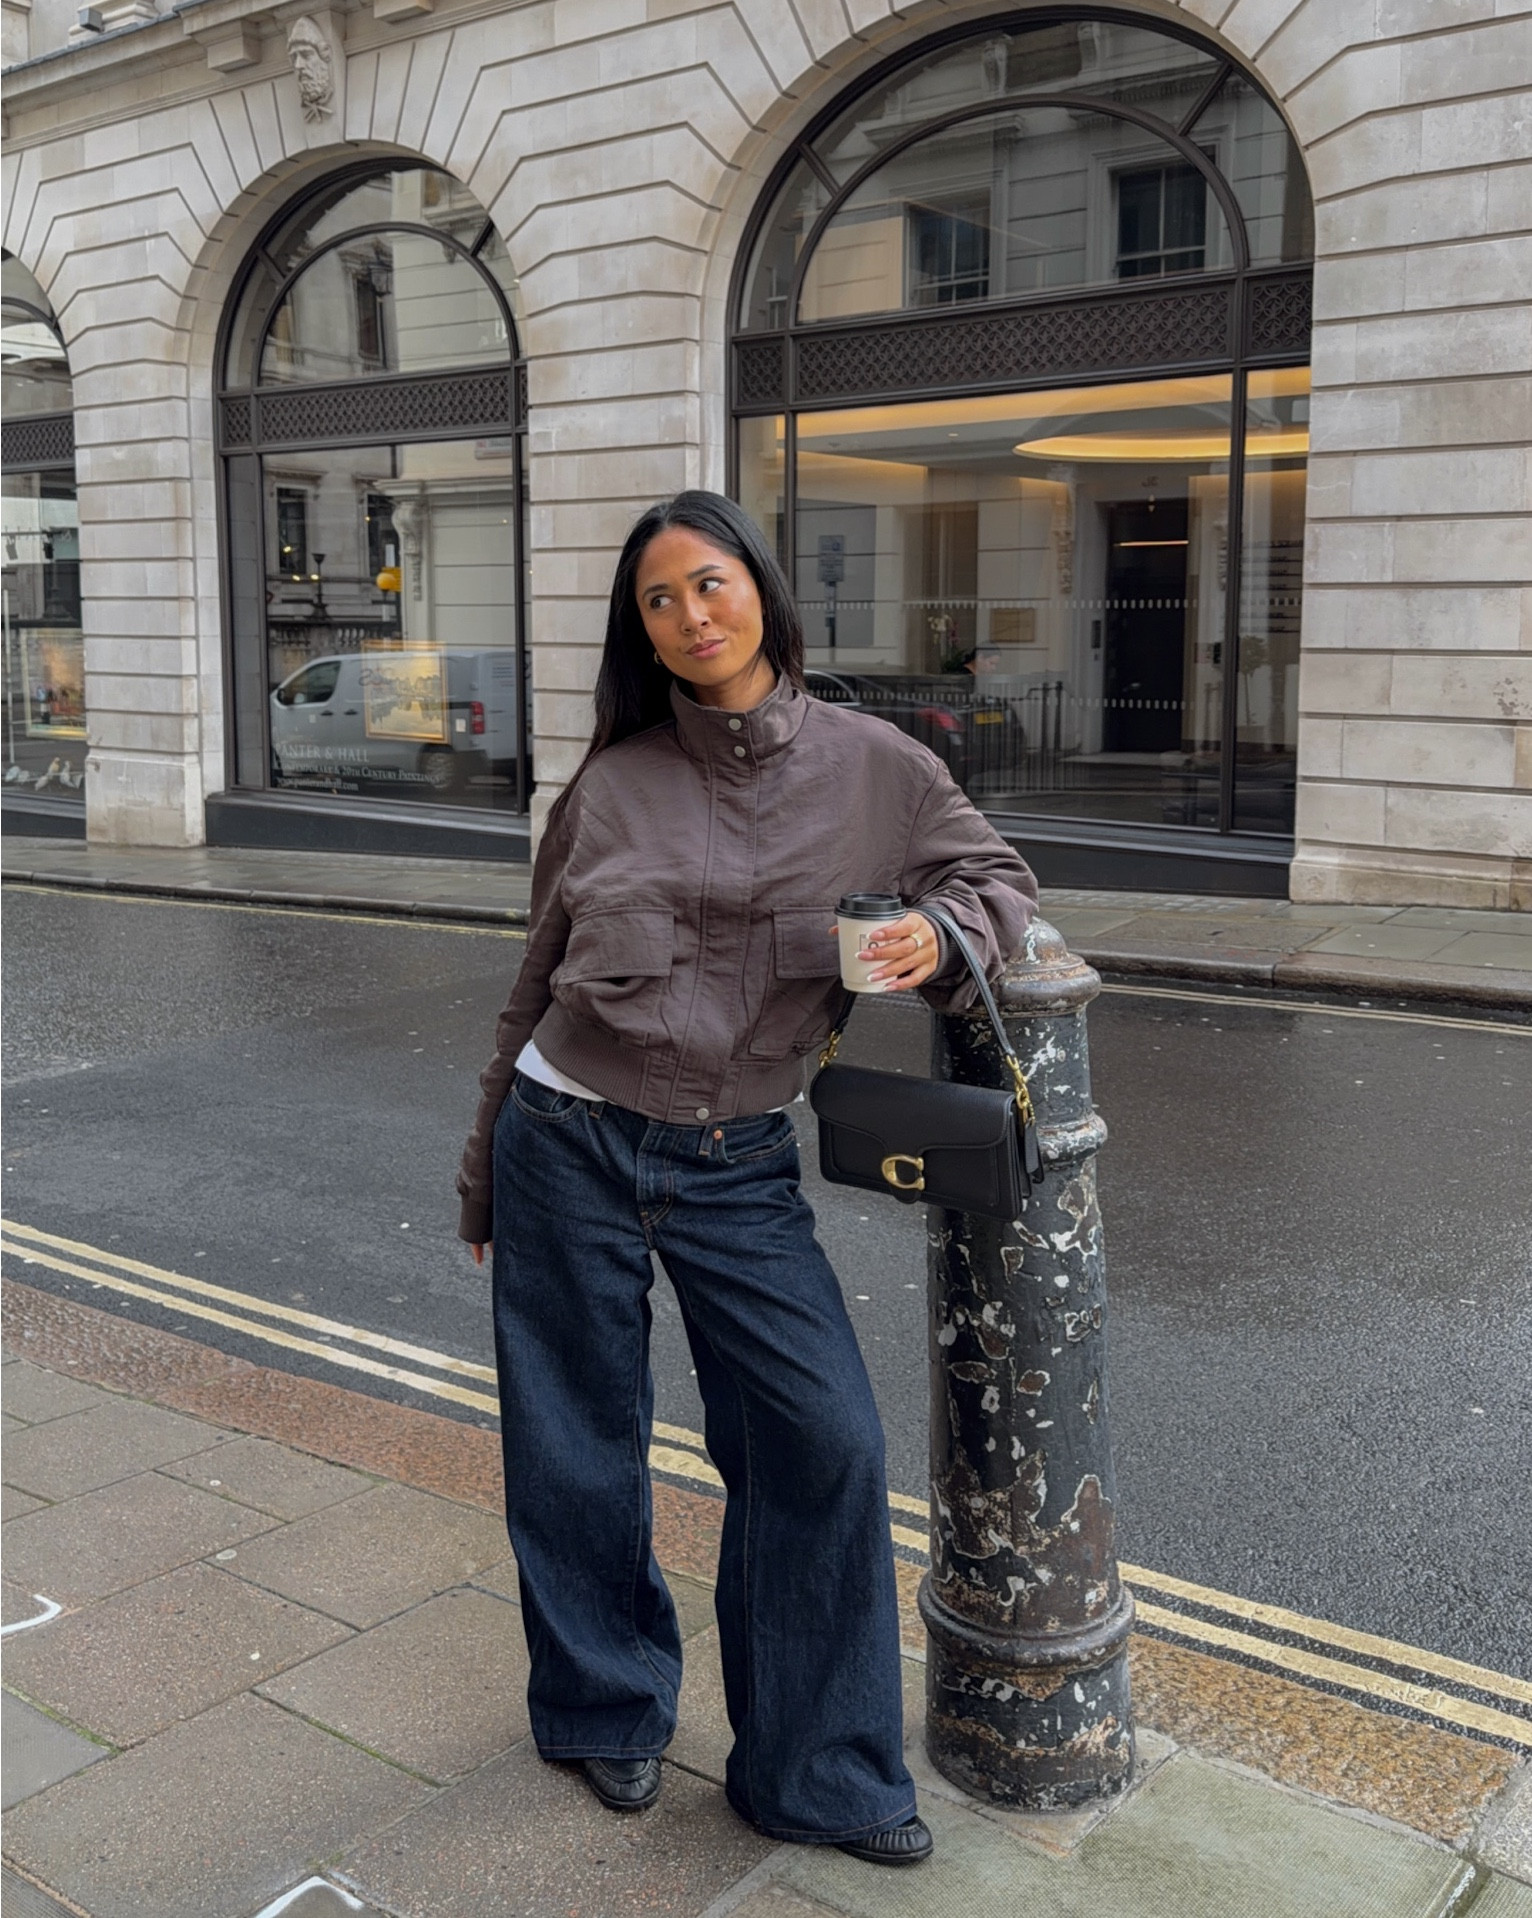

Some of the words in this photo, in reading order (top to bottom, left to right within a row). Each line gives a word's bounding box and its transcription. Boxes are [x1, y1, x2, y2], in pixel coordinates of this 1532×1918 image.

[275, 742, 320, 759] PANTER
[325, 745, 334, 760] &
[339, 747, 370, 763] HALL
[361, 766, 397, 780] CENTURY
